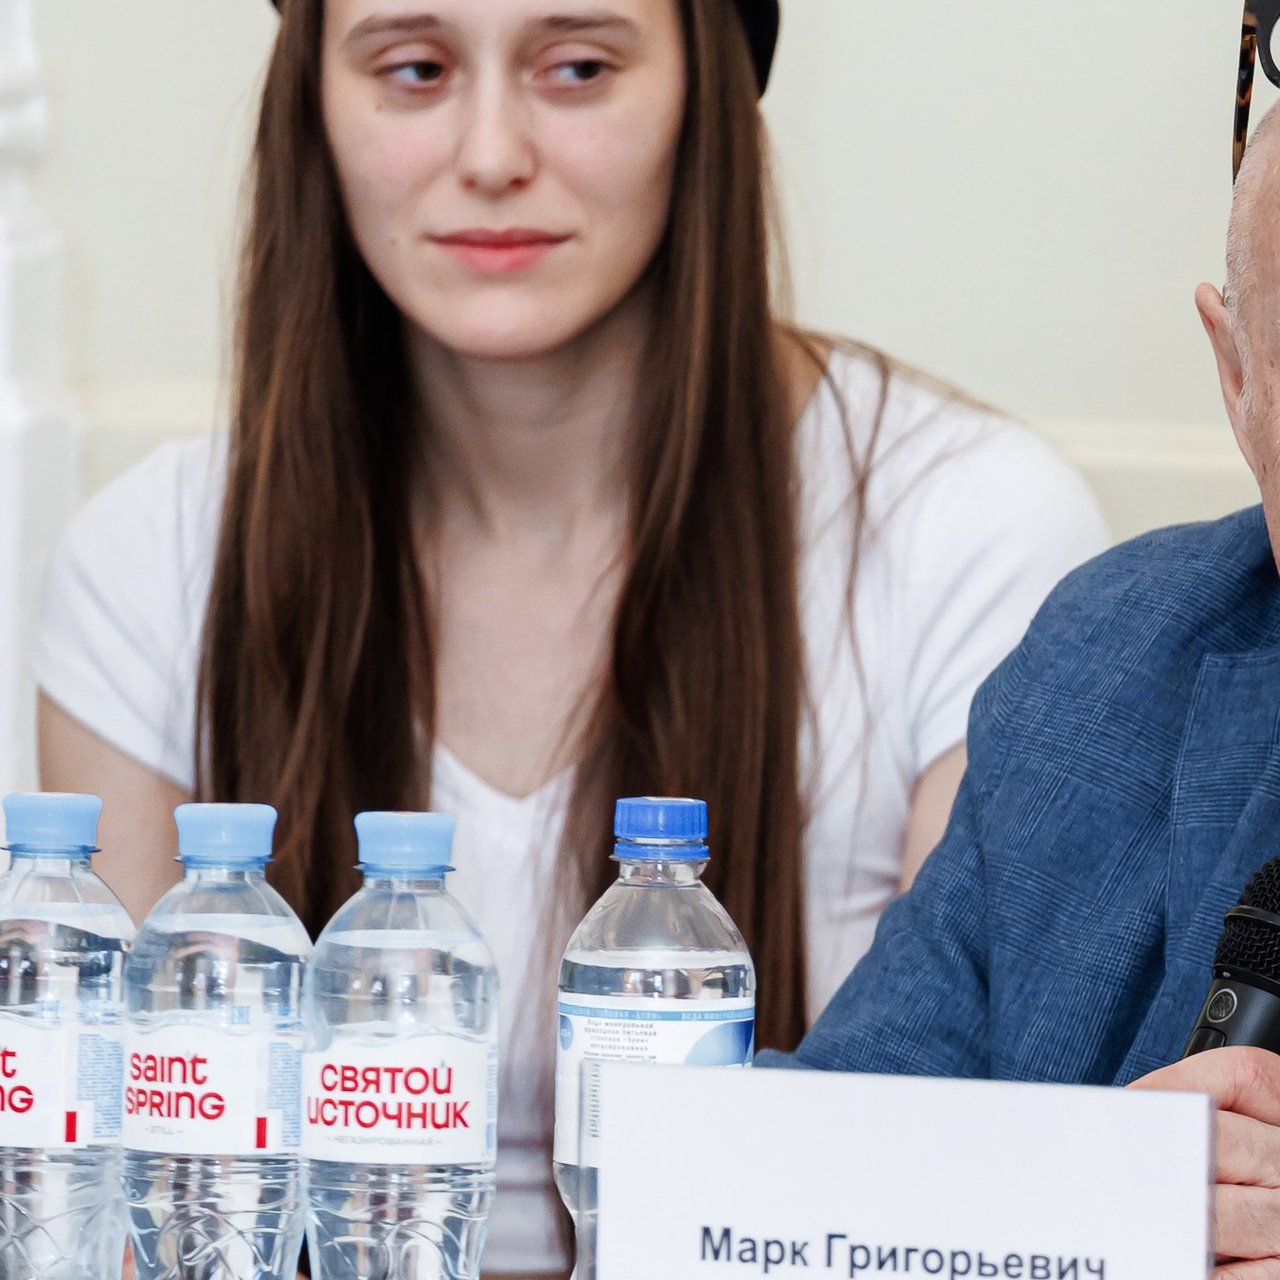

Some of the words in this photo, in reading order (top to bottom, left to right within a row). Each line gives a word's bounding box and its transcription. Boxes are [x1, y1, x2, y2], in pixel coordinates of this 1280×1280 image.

[320, 1062, 452, 1095] СВЯТОЙ
[307, 1096, 470, 1129] ИСТОЧНИК
[700, 1226, 810, 1273] Марк
